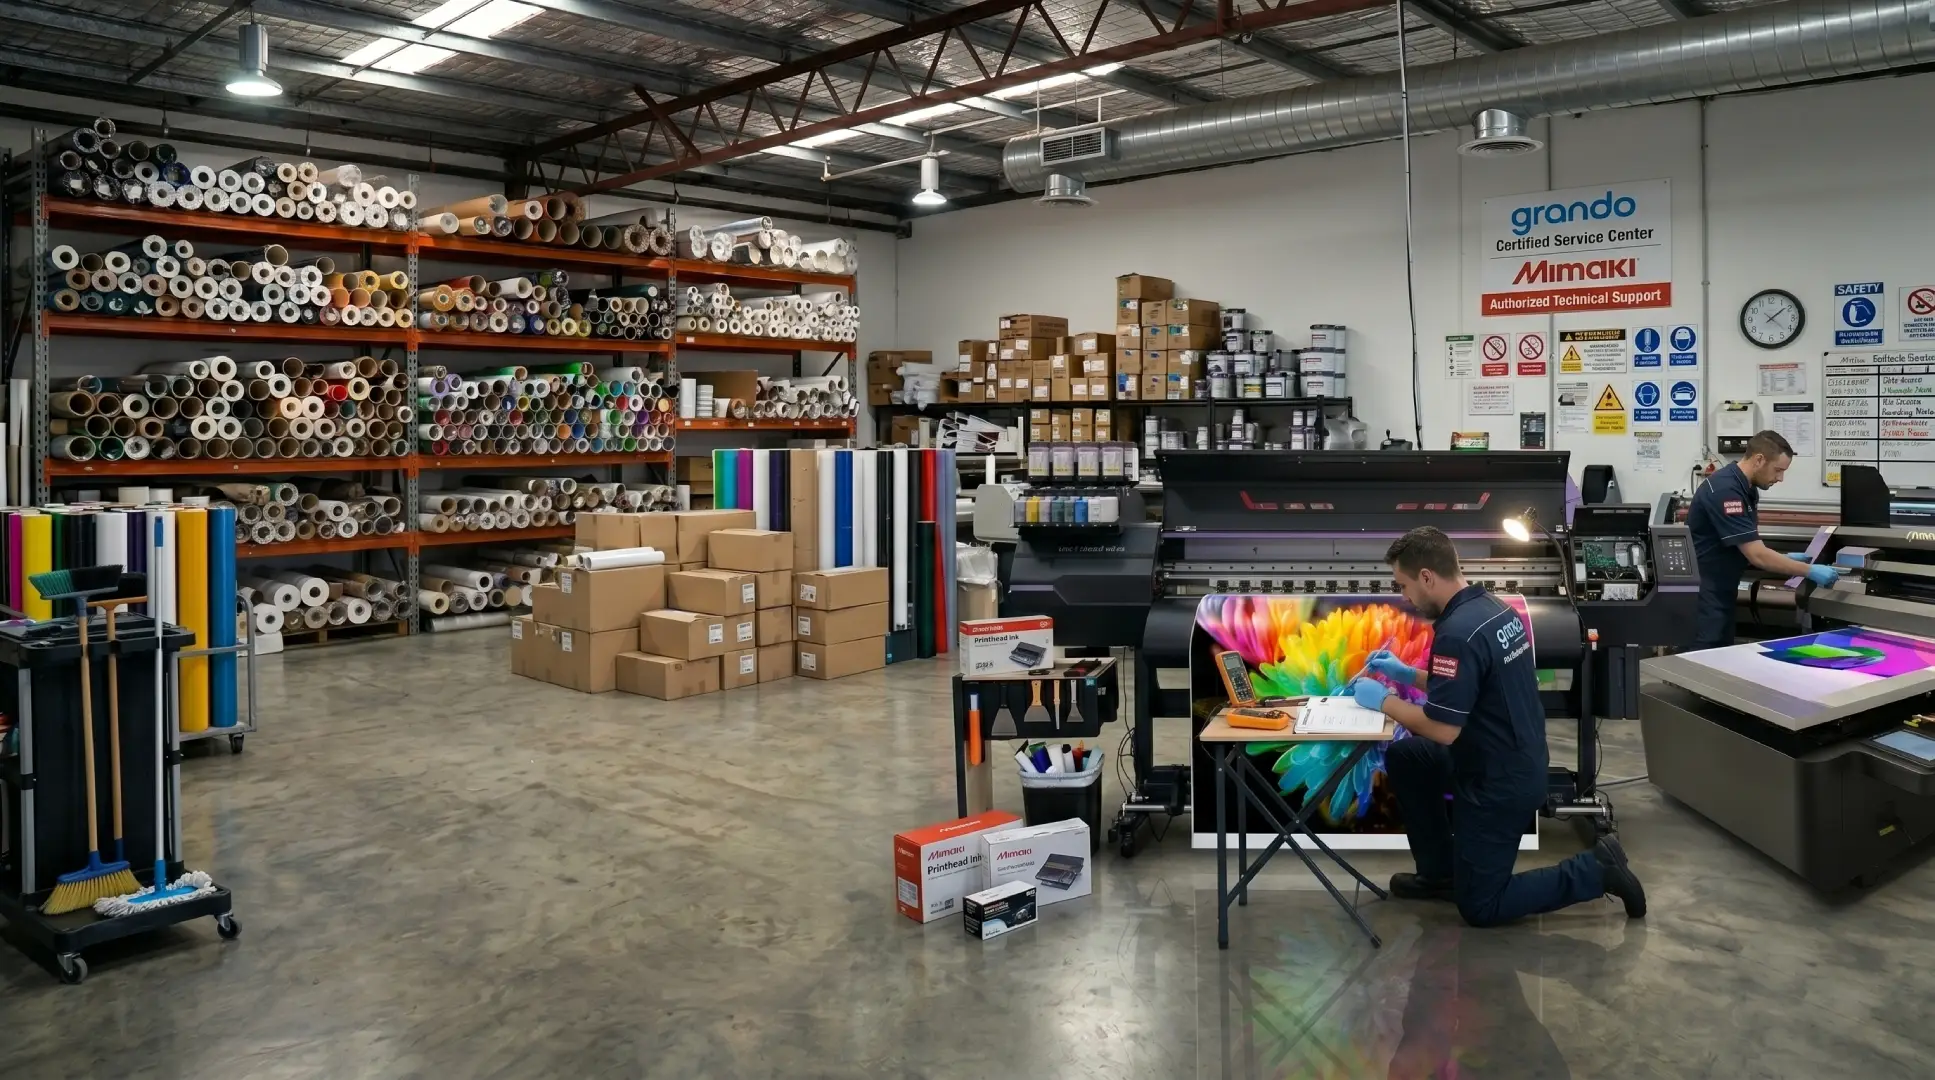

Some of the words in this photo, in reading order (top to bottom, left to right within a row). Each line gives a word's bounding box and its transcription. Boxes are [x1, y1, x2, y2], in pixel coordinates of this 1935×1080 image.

[1511, 191, 1636, 236] grando
[1496, 236, 1550, 252] Certified
[1554, 232, 1604, 246] Service
[1608, 227, 1654, 242] Center
[1837, 283, 1880, 294] SAFETY
[1490, 296, 1550, 310] Authorized
[1553, 292, 1608, 306] Technical
[1612, 289, 1662, 304] Support
[1791, 314, 1795, 322] 3
[974, 635, 1008, 644] Printhead
[928, 856, 968, 875] Printhead
